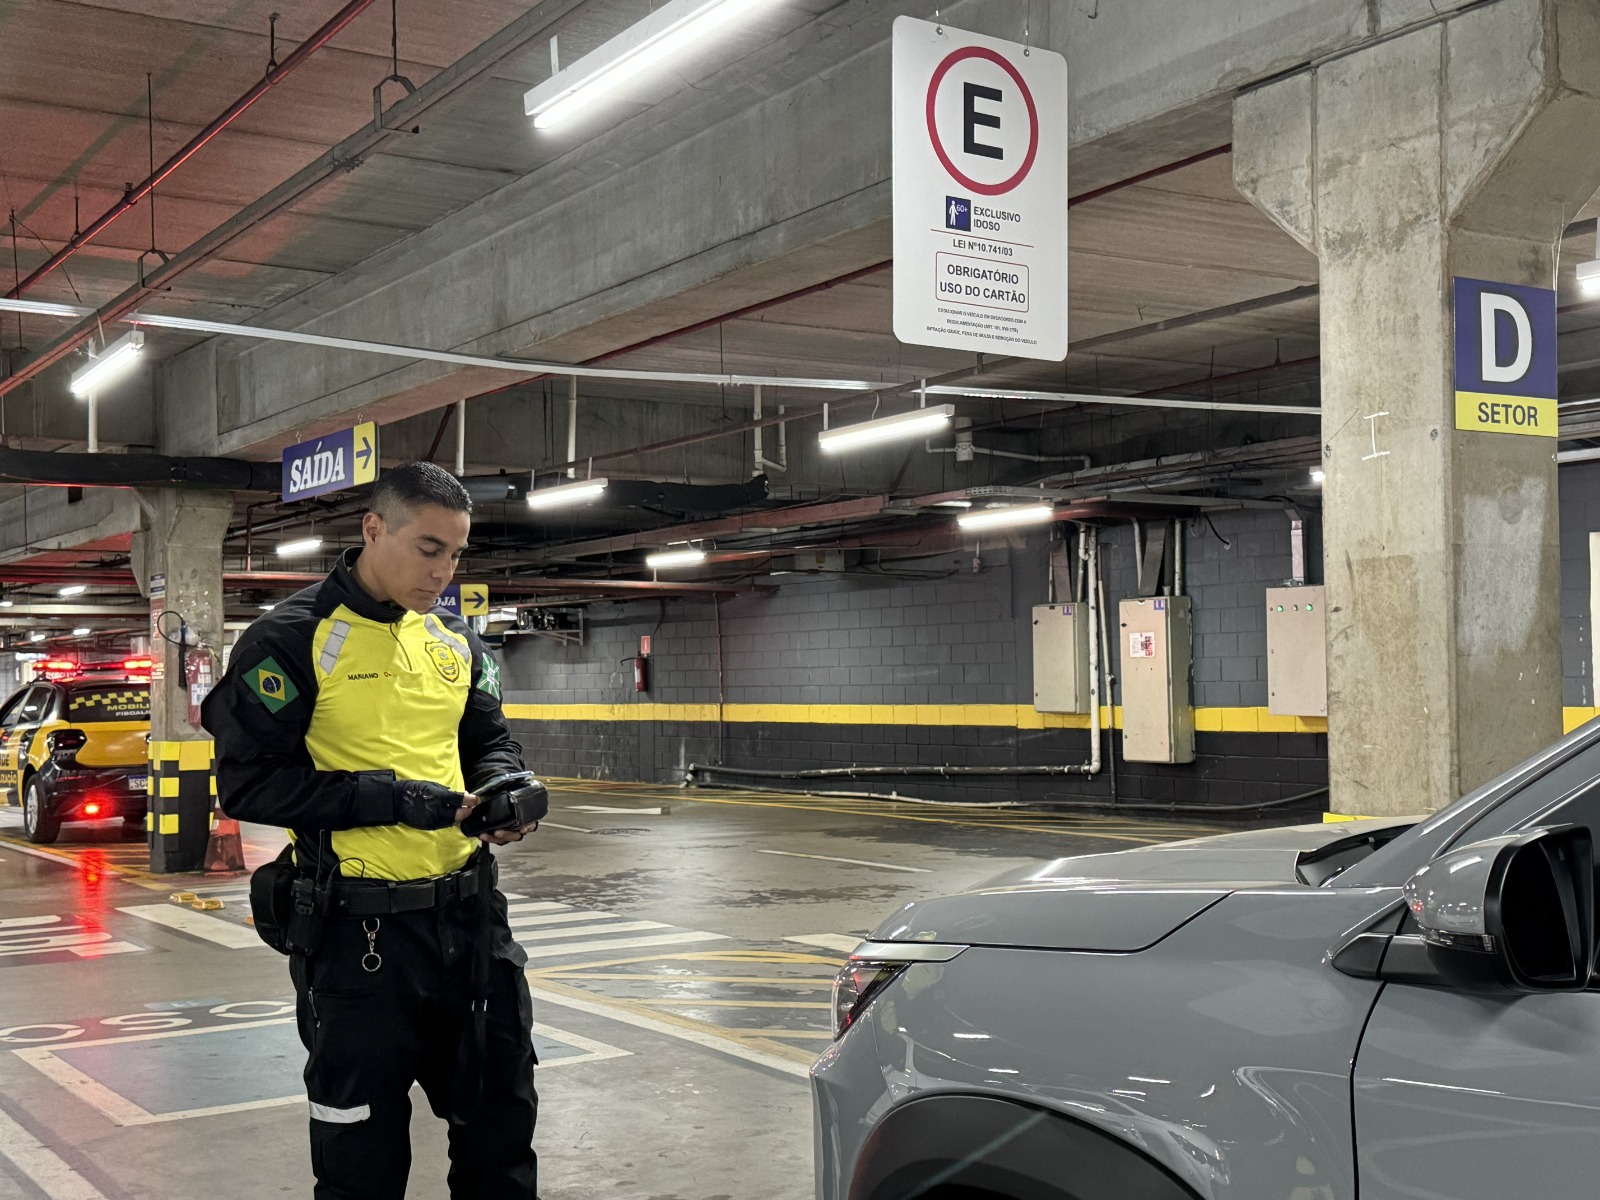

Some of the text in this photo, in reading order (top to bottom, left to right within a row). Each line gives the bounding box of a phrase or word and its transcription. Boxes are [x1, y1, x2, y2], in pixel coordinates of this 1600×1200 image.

[963, 81, 1003, 161] E
[973, 206, 1021, 223] EXCLUSIVO
[973, 219, 1001, 232] IDOSO
[953, 238, 966, 249] LEI
[947, 264, 1019, 285] OBRIGATÓRIO
[939, 281, 1026, 304] USO DO CARTÃO
[1480, 291, 1533, 383] D
[1478, 401, 1538, 427] SETOR
[289, 440, 346, 494] SAÍDA
[433, 596, 457, 607] OJA
[347, 672, 378, 680] MARIANO
[106, 703, 150, 712] MOBILI
